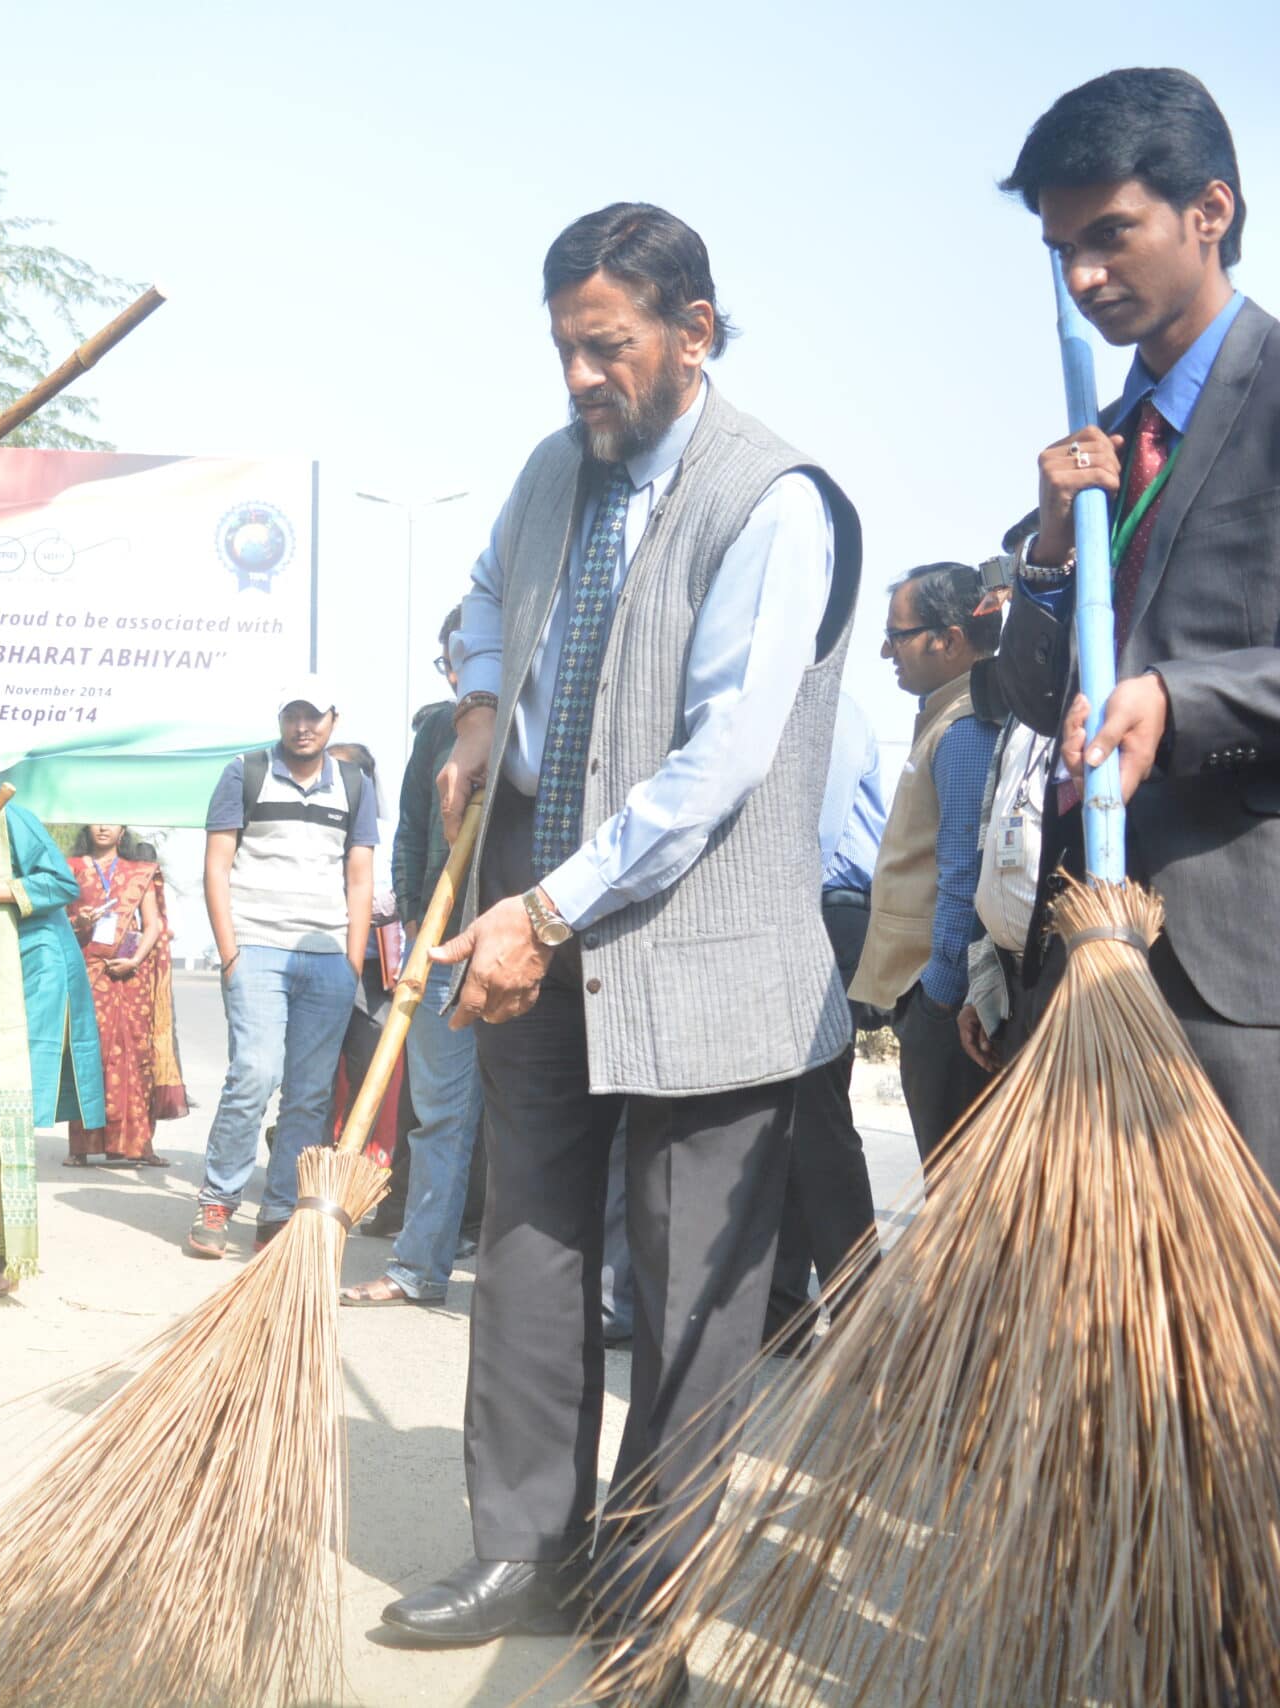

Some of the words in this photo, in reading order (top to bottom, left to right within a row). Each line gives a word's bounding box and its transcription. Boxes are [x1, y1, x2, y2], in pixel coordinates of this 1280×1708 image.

[55, 612, 77, 628] to
[83, 611, 109, 629] be
[115, 613, 231, 633] associated
[237, 616, 283, 634] with
[97, 647, 227, 669] ABHIYAN"
[4, 684, 75, 697] November
[79, 686, 112, 697] 2014
